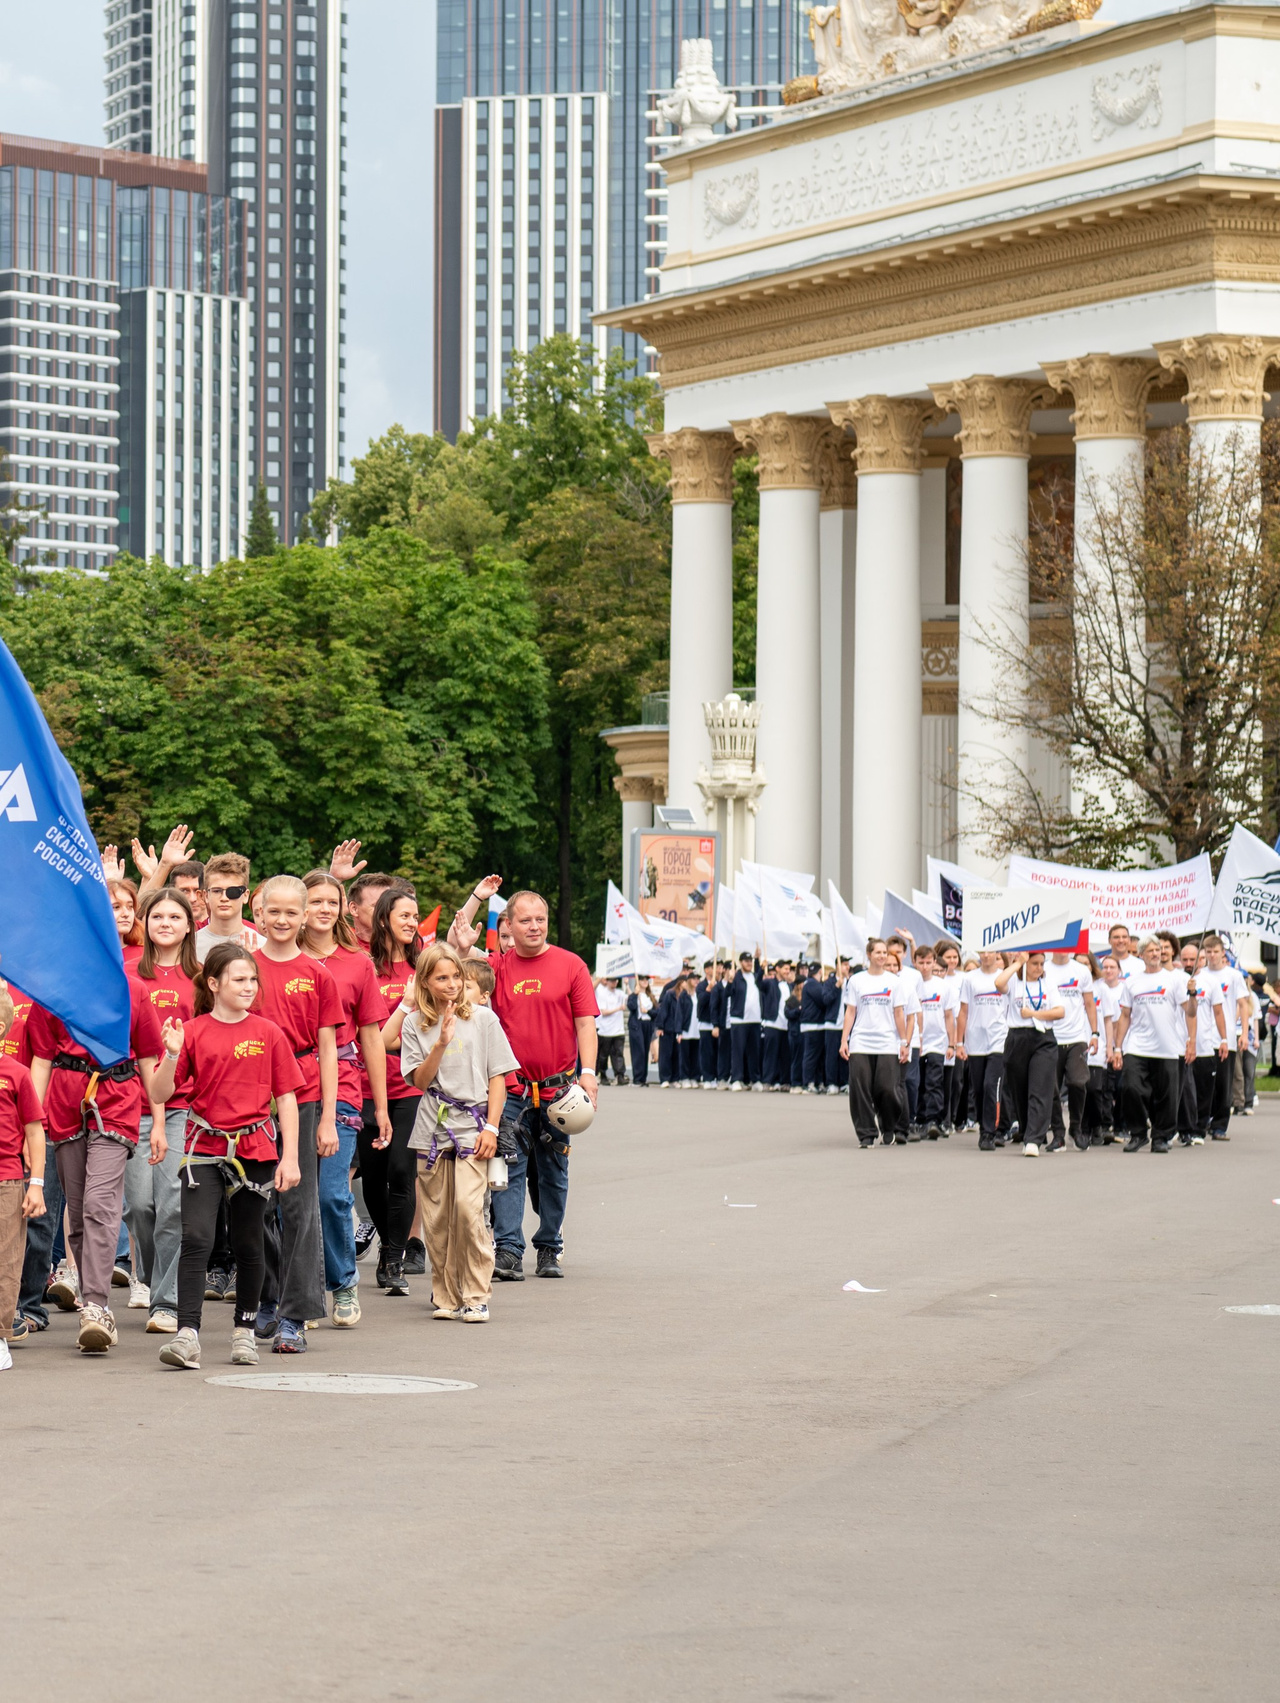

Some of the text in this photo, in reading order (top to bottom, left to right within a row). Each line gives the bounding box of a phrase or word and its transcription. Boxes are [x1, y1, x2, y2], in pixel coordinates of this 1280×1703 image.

[812, 90, 1028, 169] РОССИЙСКАЯ
[771, 103, 1078, 204] СОВЕТСКАЯ ФЕДЕРАТИВНАЯ
[770, 132, 1082, 229] СОЦИАЛИСТИЧЕСКАЯ РЕСПУБЛИКА
[33, 840, 83, 885] РОССИИ
[663, 851, 691, 866] ГОРОД
[663, 866, 691, 875] ВДНХ
[1031, 872, 1196, 893] ВОЗРОДИСЬ, ФИЗКУЛЬТПАРАД!
[1235, 882, 1280, 904] РОССИ
[1091, 888, 1189, 907] РЁД И ШАГ НАЗАД!
[1232, 895, 1280, 917] ФЕДЕР
[1126, 907, 1155, 919] ВНИЗ
[1158, 905, 1165, 915] И
[1134, 913, 1193, 931] ТАМ УСПЕХ!
[982, 903, 1040, 948] ПАРКУР
